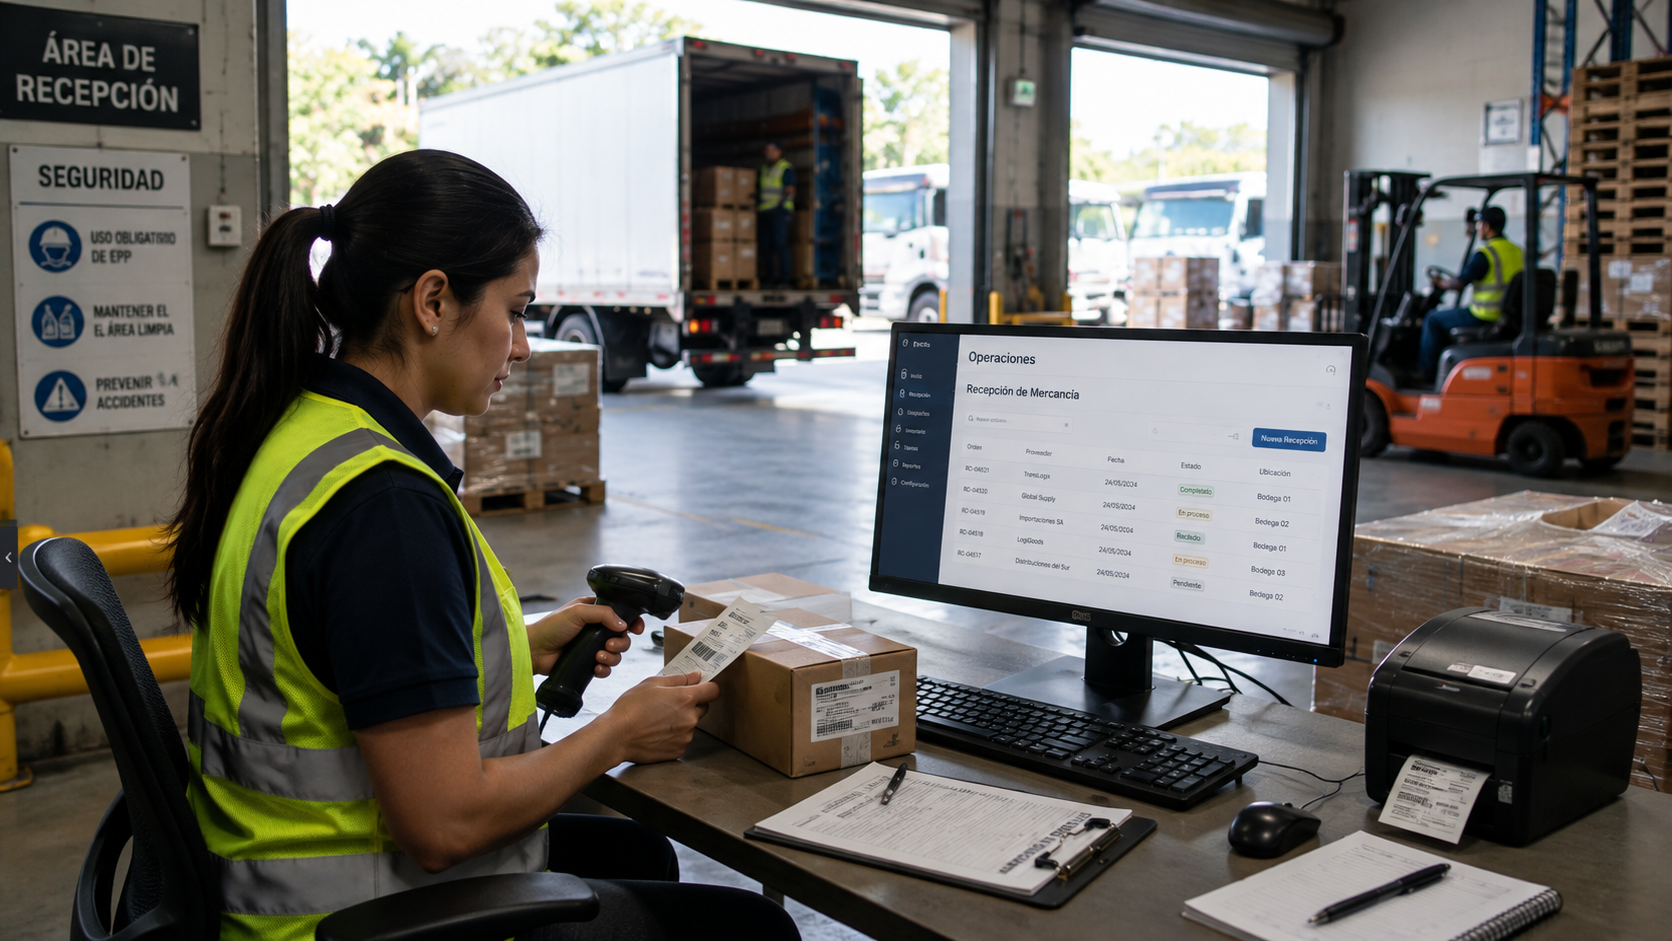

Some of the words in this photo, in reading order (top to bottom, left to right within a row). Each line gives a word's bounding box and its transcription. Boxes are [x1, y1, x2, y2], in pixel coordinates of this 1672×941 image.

[42, 30, 116, 69] ÁREA
[122, 44, 156, 73] DE
[16, 73, 179, 113] RECEPCIÓN
[38, 164, 165, 191] SEGURIDAD
[90, 230, 113, 245] USO
[91, 249, 107, 264] DE
[109, 249, 132, 264] EPP
[93, 304, 154, 319] MANTENER
[156, 303, 169, 318] EL
[137, 322, 174, 336] LIMPIA
[968, 350, 1036, 365] Operaciones
[96, 375, 153, 391] PREVENIR
[966, 383, 1014, 397] Recepción
[1015, 386, 1028, 397] de
[97, 393, 166, 410] ACCIDENTES
[1107, 456, 1125, 464] Fecha
[1181, 462, 1202, 470] Estado
[1259, 468, 1291, 477] Ubicación
[1280, 520, 1289, 528] 02
[1274, 593, 1284, 601] 02
